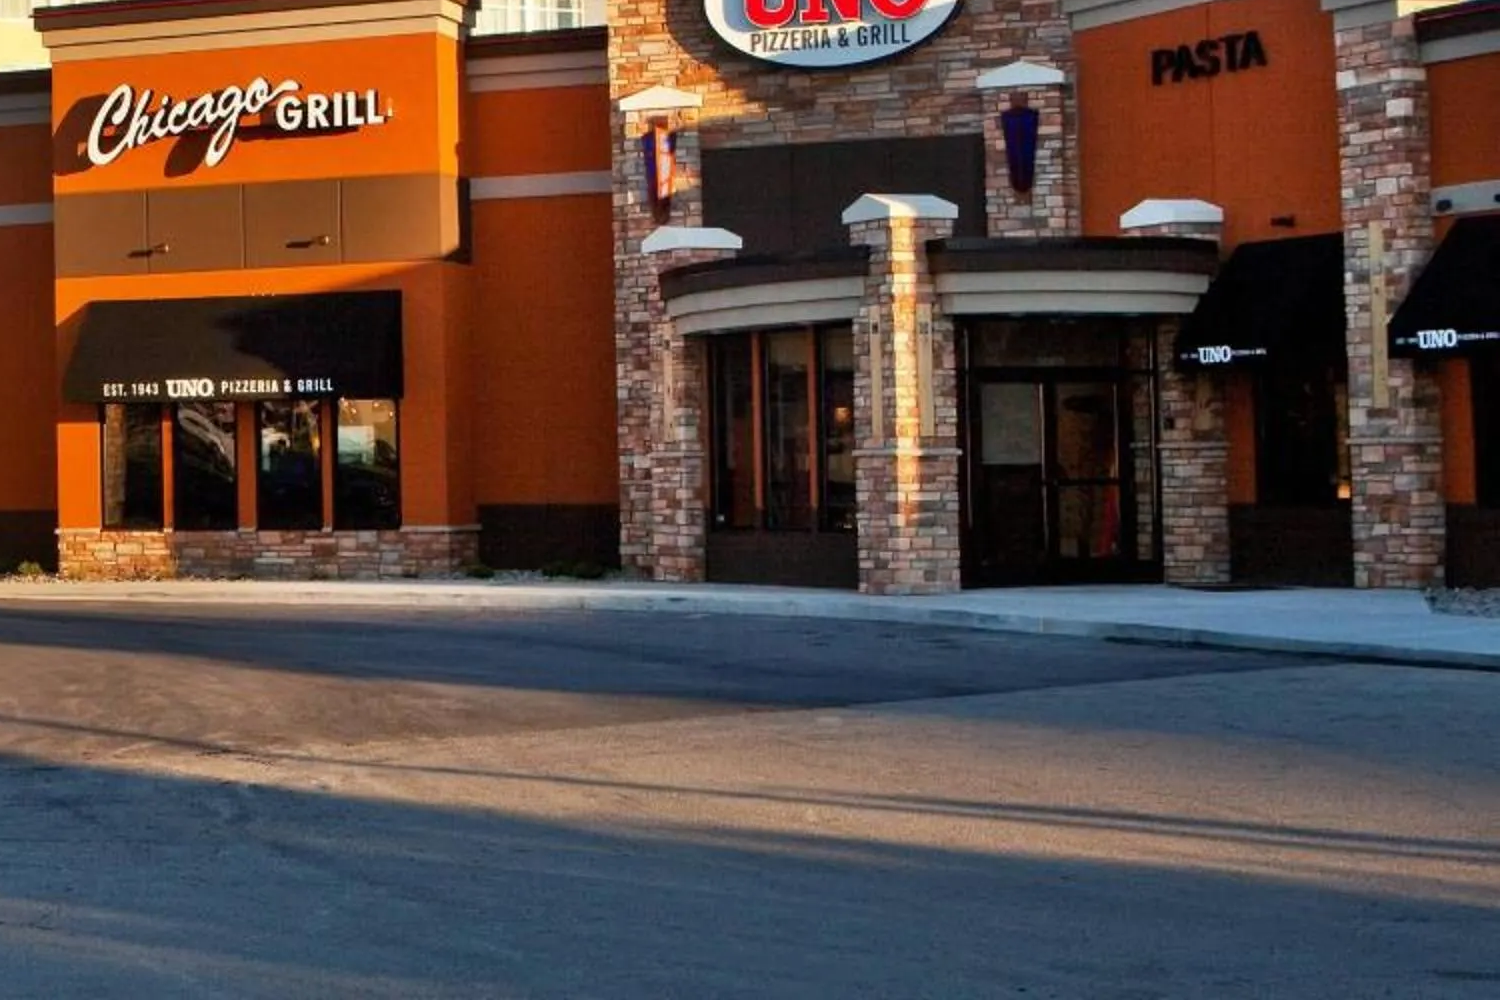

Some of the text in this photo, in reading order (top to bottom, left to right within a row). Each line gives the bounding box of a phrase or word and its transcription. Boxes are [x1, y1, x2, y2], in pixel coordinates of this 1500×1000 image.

[750, 23, 912, 53] PIZZERIA & GRILL
[1151, 30, 1268, 86] PASTA
[87, 76, 386, 168] Chicago GRILL
[1416, 328, 1457, 349] UNO
[1197, 345, 1232, 364] UNO
[102, 378, 333, 397] EST. 1943 UNO PIZZERIA & GRILL
